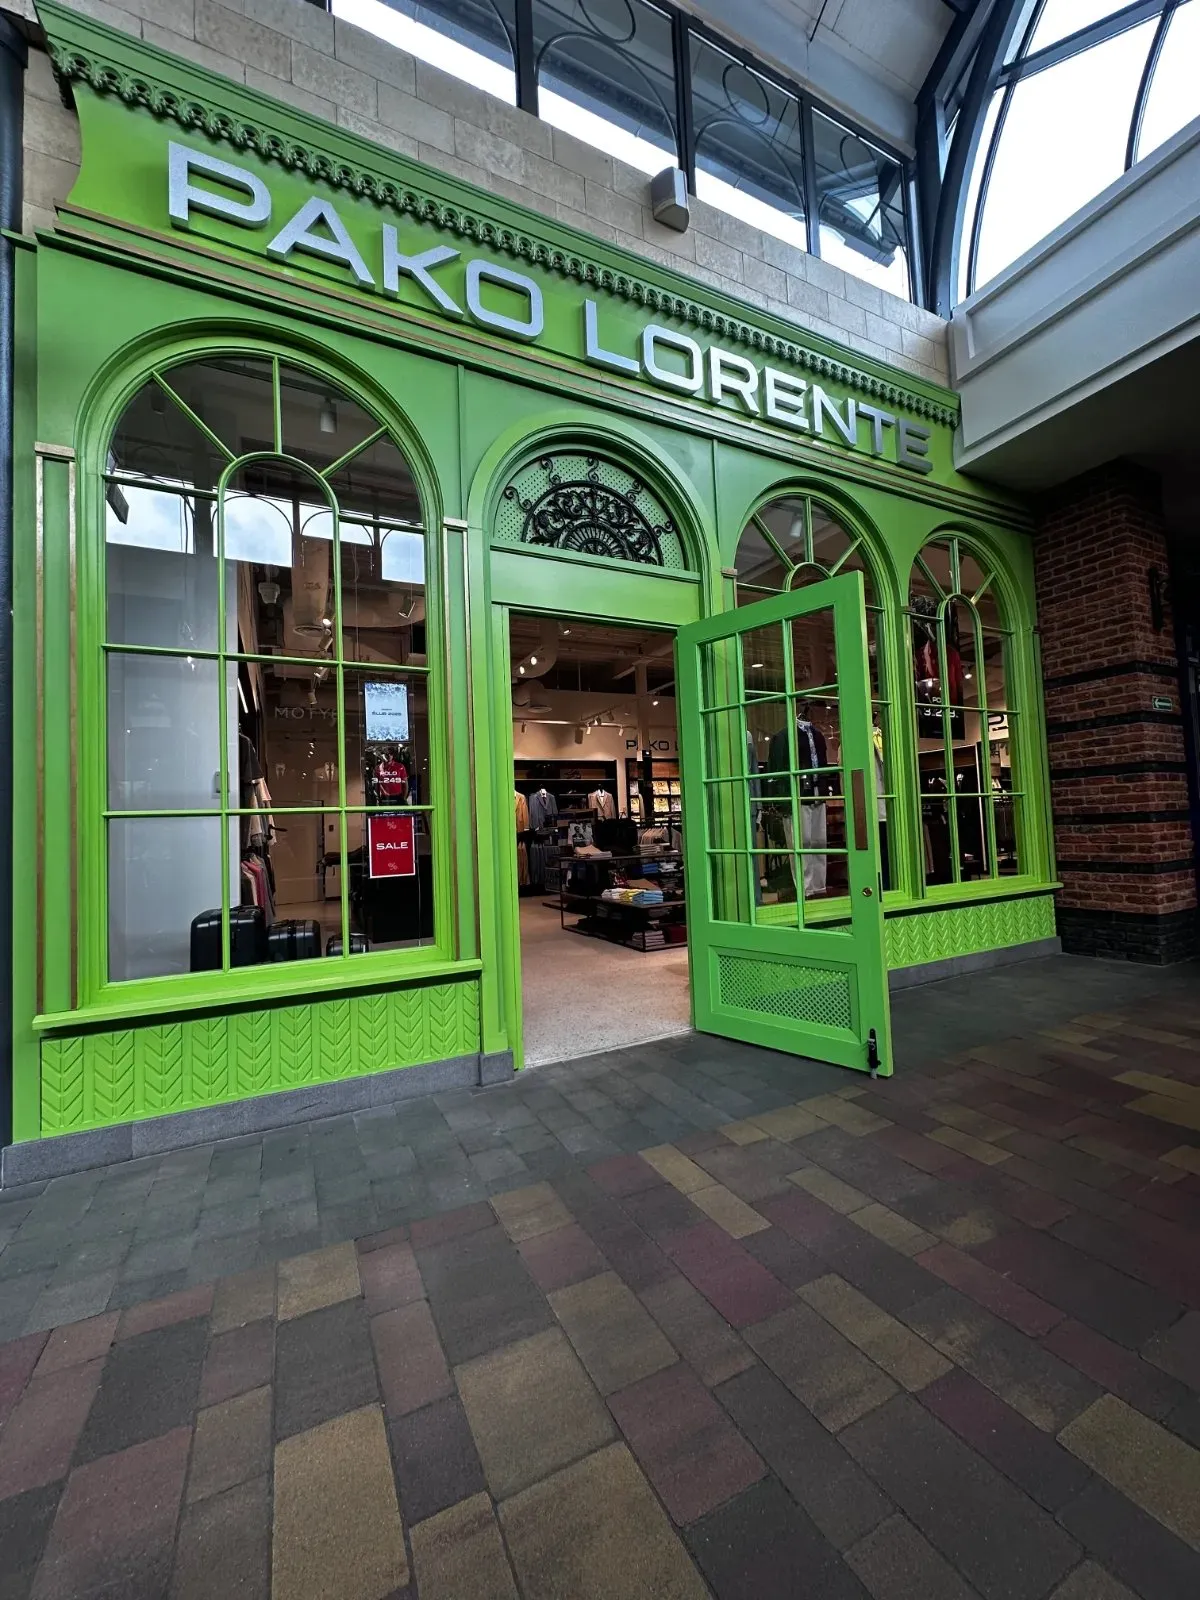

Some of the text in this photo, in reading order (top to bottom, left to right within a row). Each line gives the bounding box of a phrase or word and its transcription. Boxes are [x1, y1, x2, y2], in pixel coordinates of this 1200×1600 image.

[168, 140, 933, 475] PAKO LORENTE
[626, 740, 670, 751] PKO
[376, 841, 409, 850] SALE
